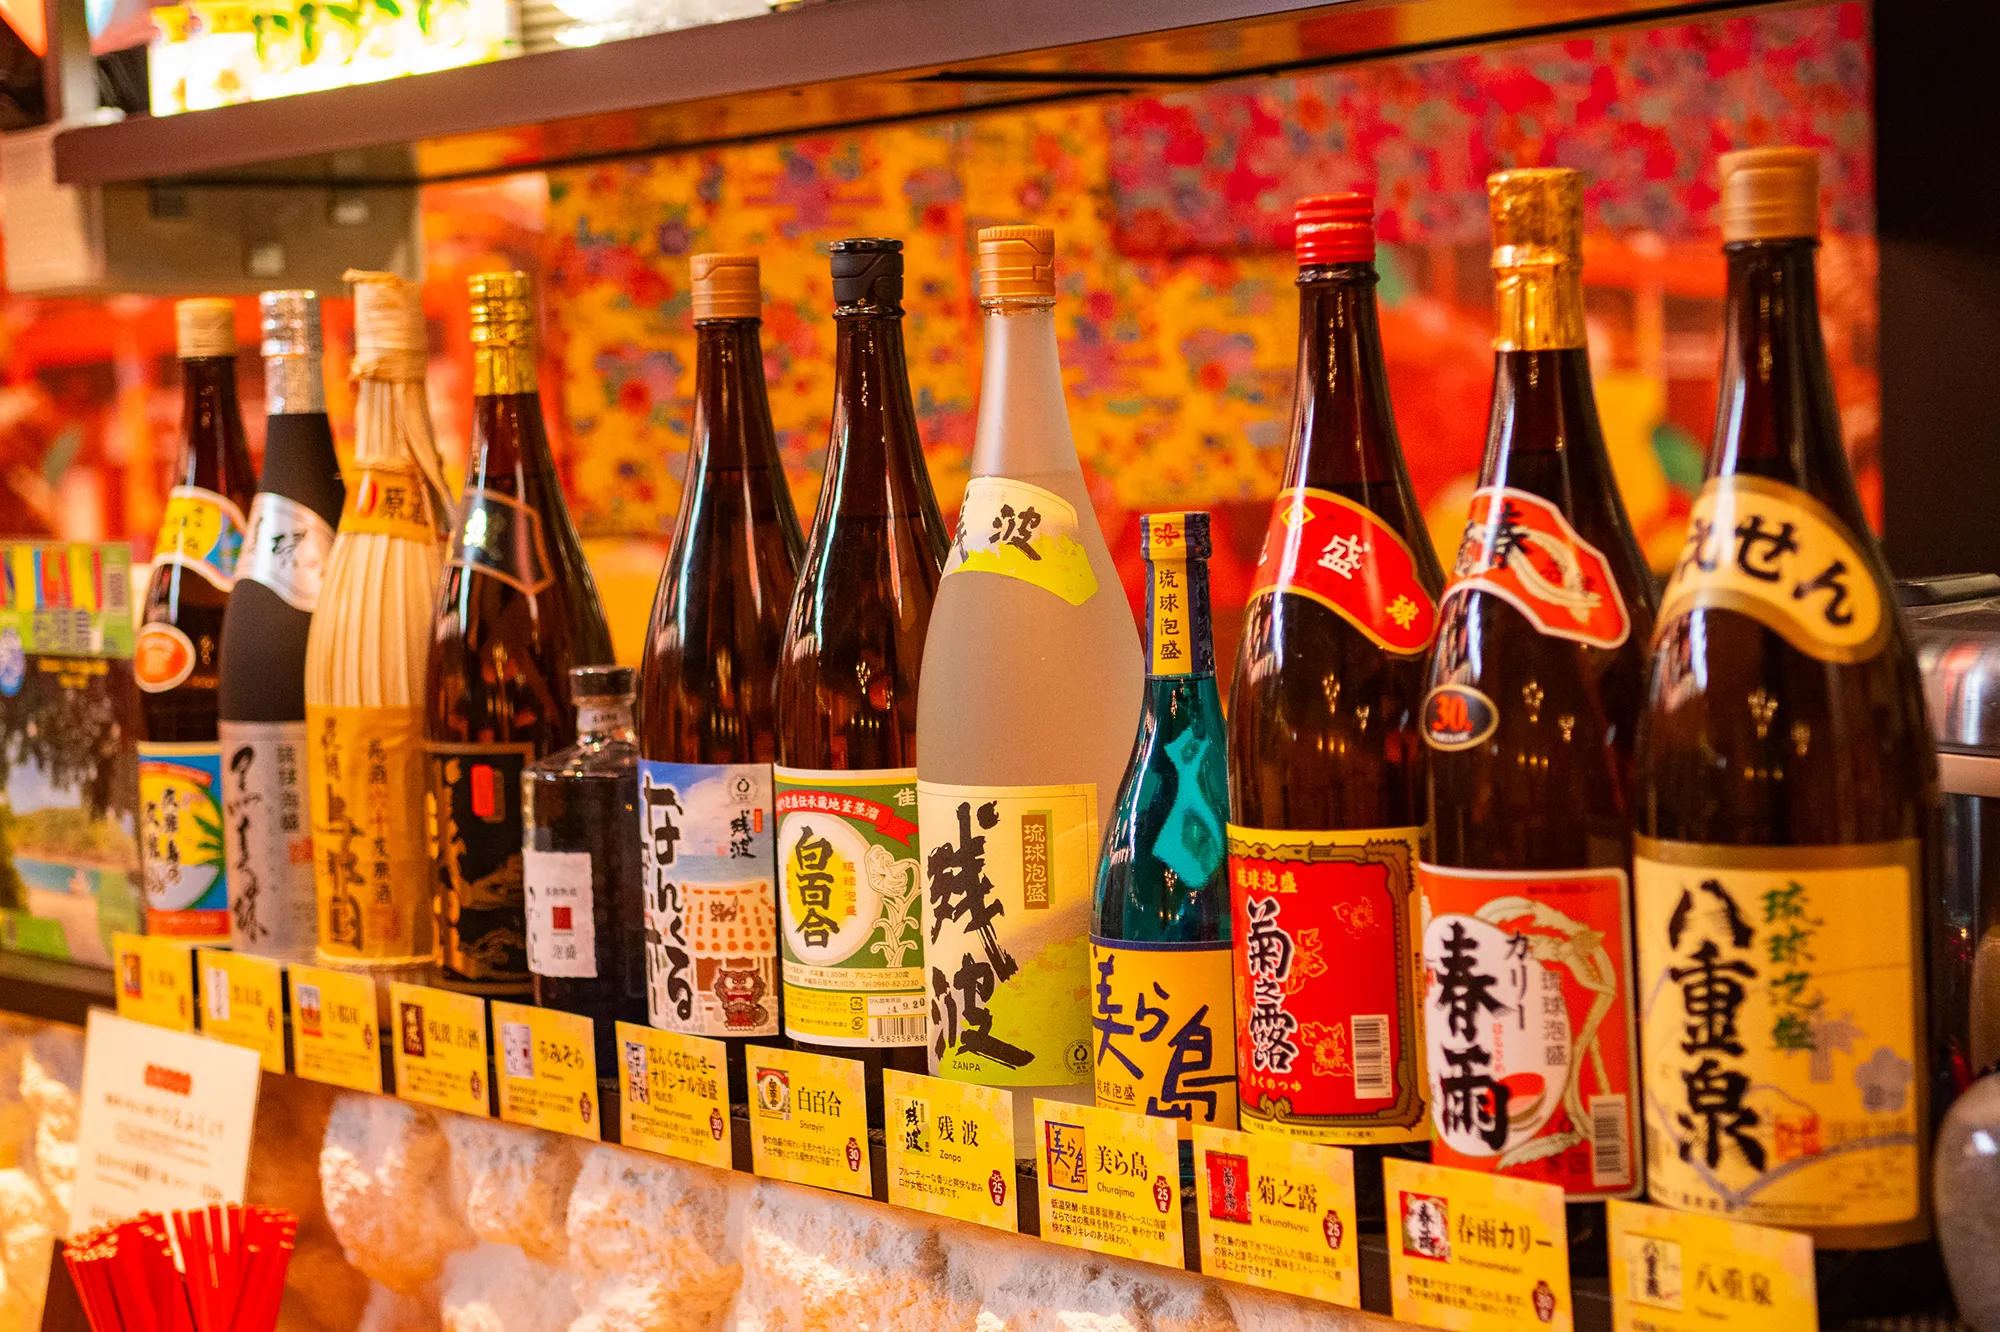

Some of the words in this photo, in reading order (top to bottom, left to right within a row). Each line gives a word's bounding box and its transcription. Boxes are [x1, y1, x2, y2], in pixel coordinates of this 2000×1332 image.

[1159, 569, 1182, 660] 琉球泡盛
[893, 786, 919, 807] 佳
[729, 809, 757, 869] 残波
[1023, 823, 1047, 903] 琉球泡盛
[1236, 868, 1299, 894] 琉球泡盛
[644, 774, 692, 1021] なんくる
[795, 825, 840, 948] 白百合
[842, 860, 857, 917] 琉球泡盛
[927, 800, 1037, 1072] 残波
[1247, 894, 1300, 1074] 菊之露
[1092, 944, 1239, 1123] 美ら島
[1434, 920, 1520, 1152] 春雨
[1667, 878, 1767, 1173] 八重泉
[952, 1060, 981, 1072] ZANPA
[797, 1086, 842, 1118] 白百合
[1097, 1079, 1136, 1101] 琉球泡盛
[905, 1100, 925, 1152] 残波
[936, 1115, 980, 1148] 残波
[939, 1149, 962, 1164] Zanpa
[1050, 1123, 1088, 1185] 美ら島
[1093, 1144, 1149, 1182] 美ら島
[898, 1167, 984, 1192] フルーティーな香りと爽快な飲み
[898, 1178, 961, 1200] 口が女性にも人気です。
[1096, 1181, 1136, 1199] Churajima
[1256, 1174, 1319, 1215] 菊之露
[1051, 1210, 1166, 1242] ならではの風味を持ちつつ、華やかで軽
[1052, 1221, 1133, 1248] 快な香りキレのある味わい。
[1259, 1214, 1310, 1236] Kikunotsuyu
[1214, 1258, 1278, 1281] じることができます。
